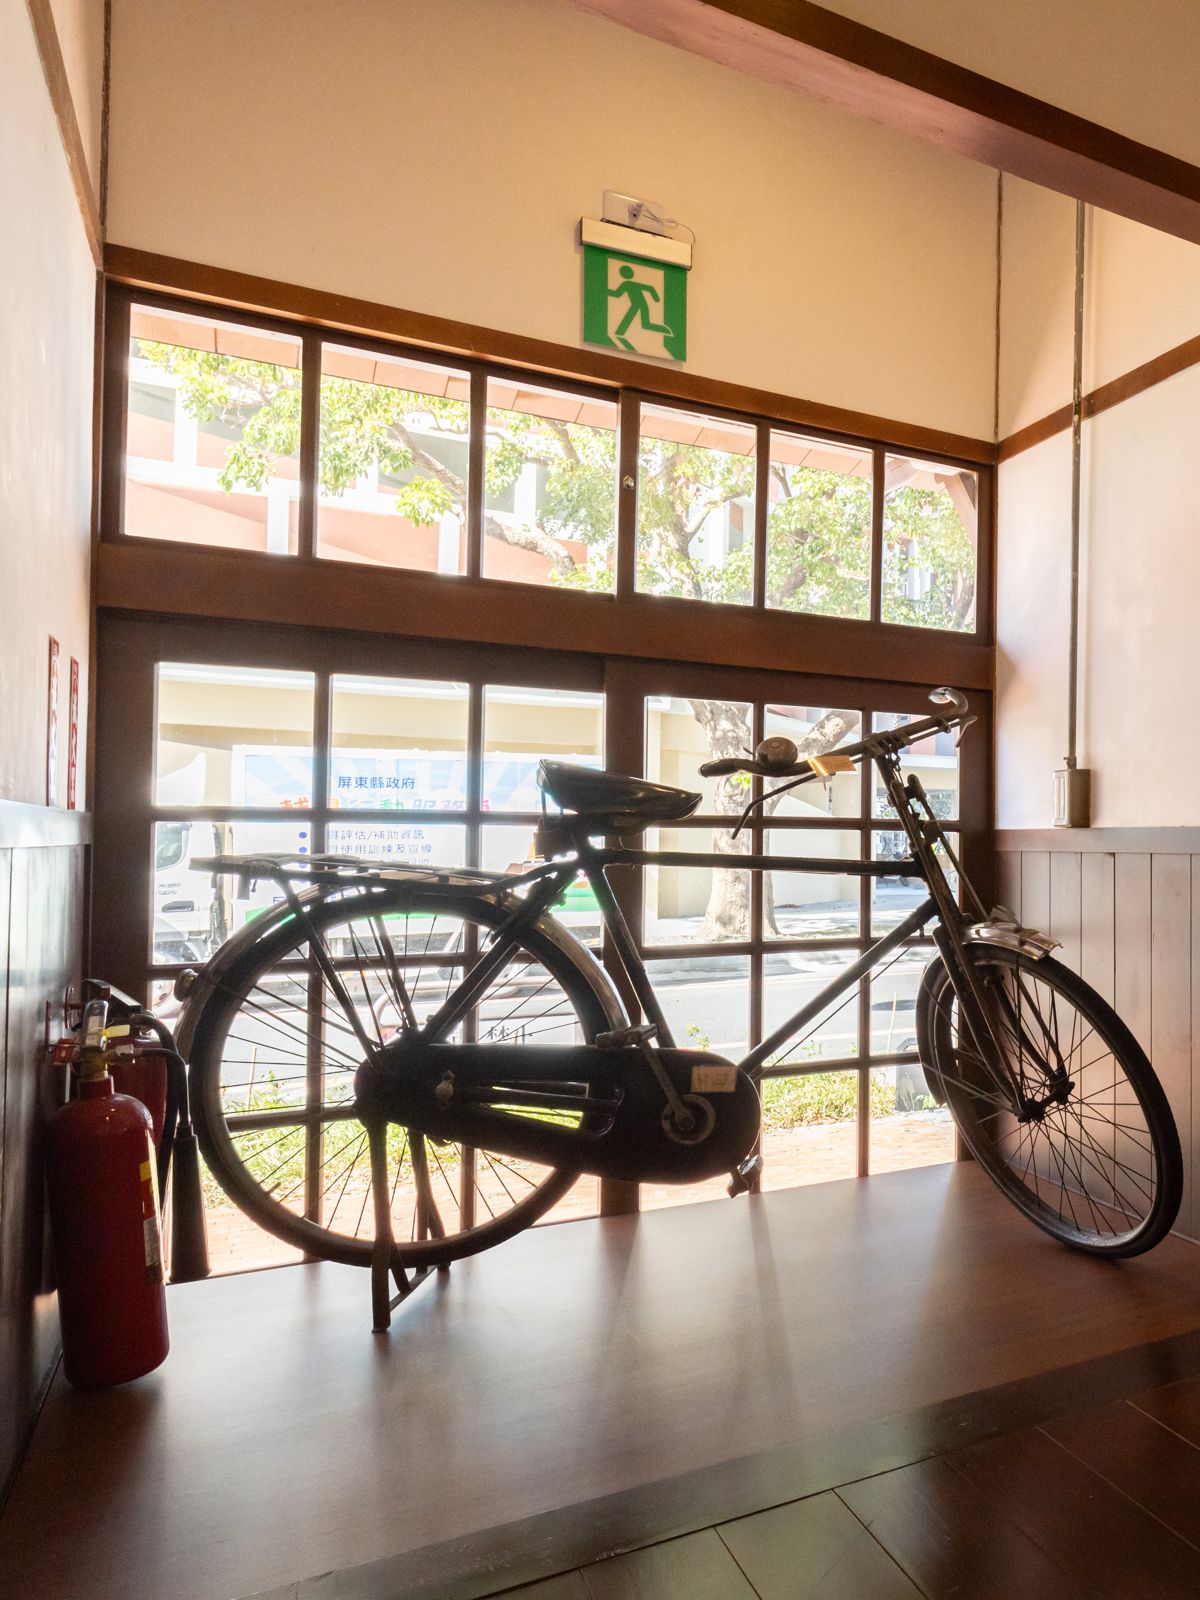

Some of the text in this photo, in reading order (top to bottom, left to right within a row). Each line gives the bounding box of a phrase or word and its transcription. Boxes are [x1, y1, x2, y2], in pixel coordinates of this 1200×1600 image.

[337, 776, 416, 790] 屏東縣政府
